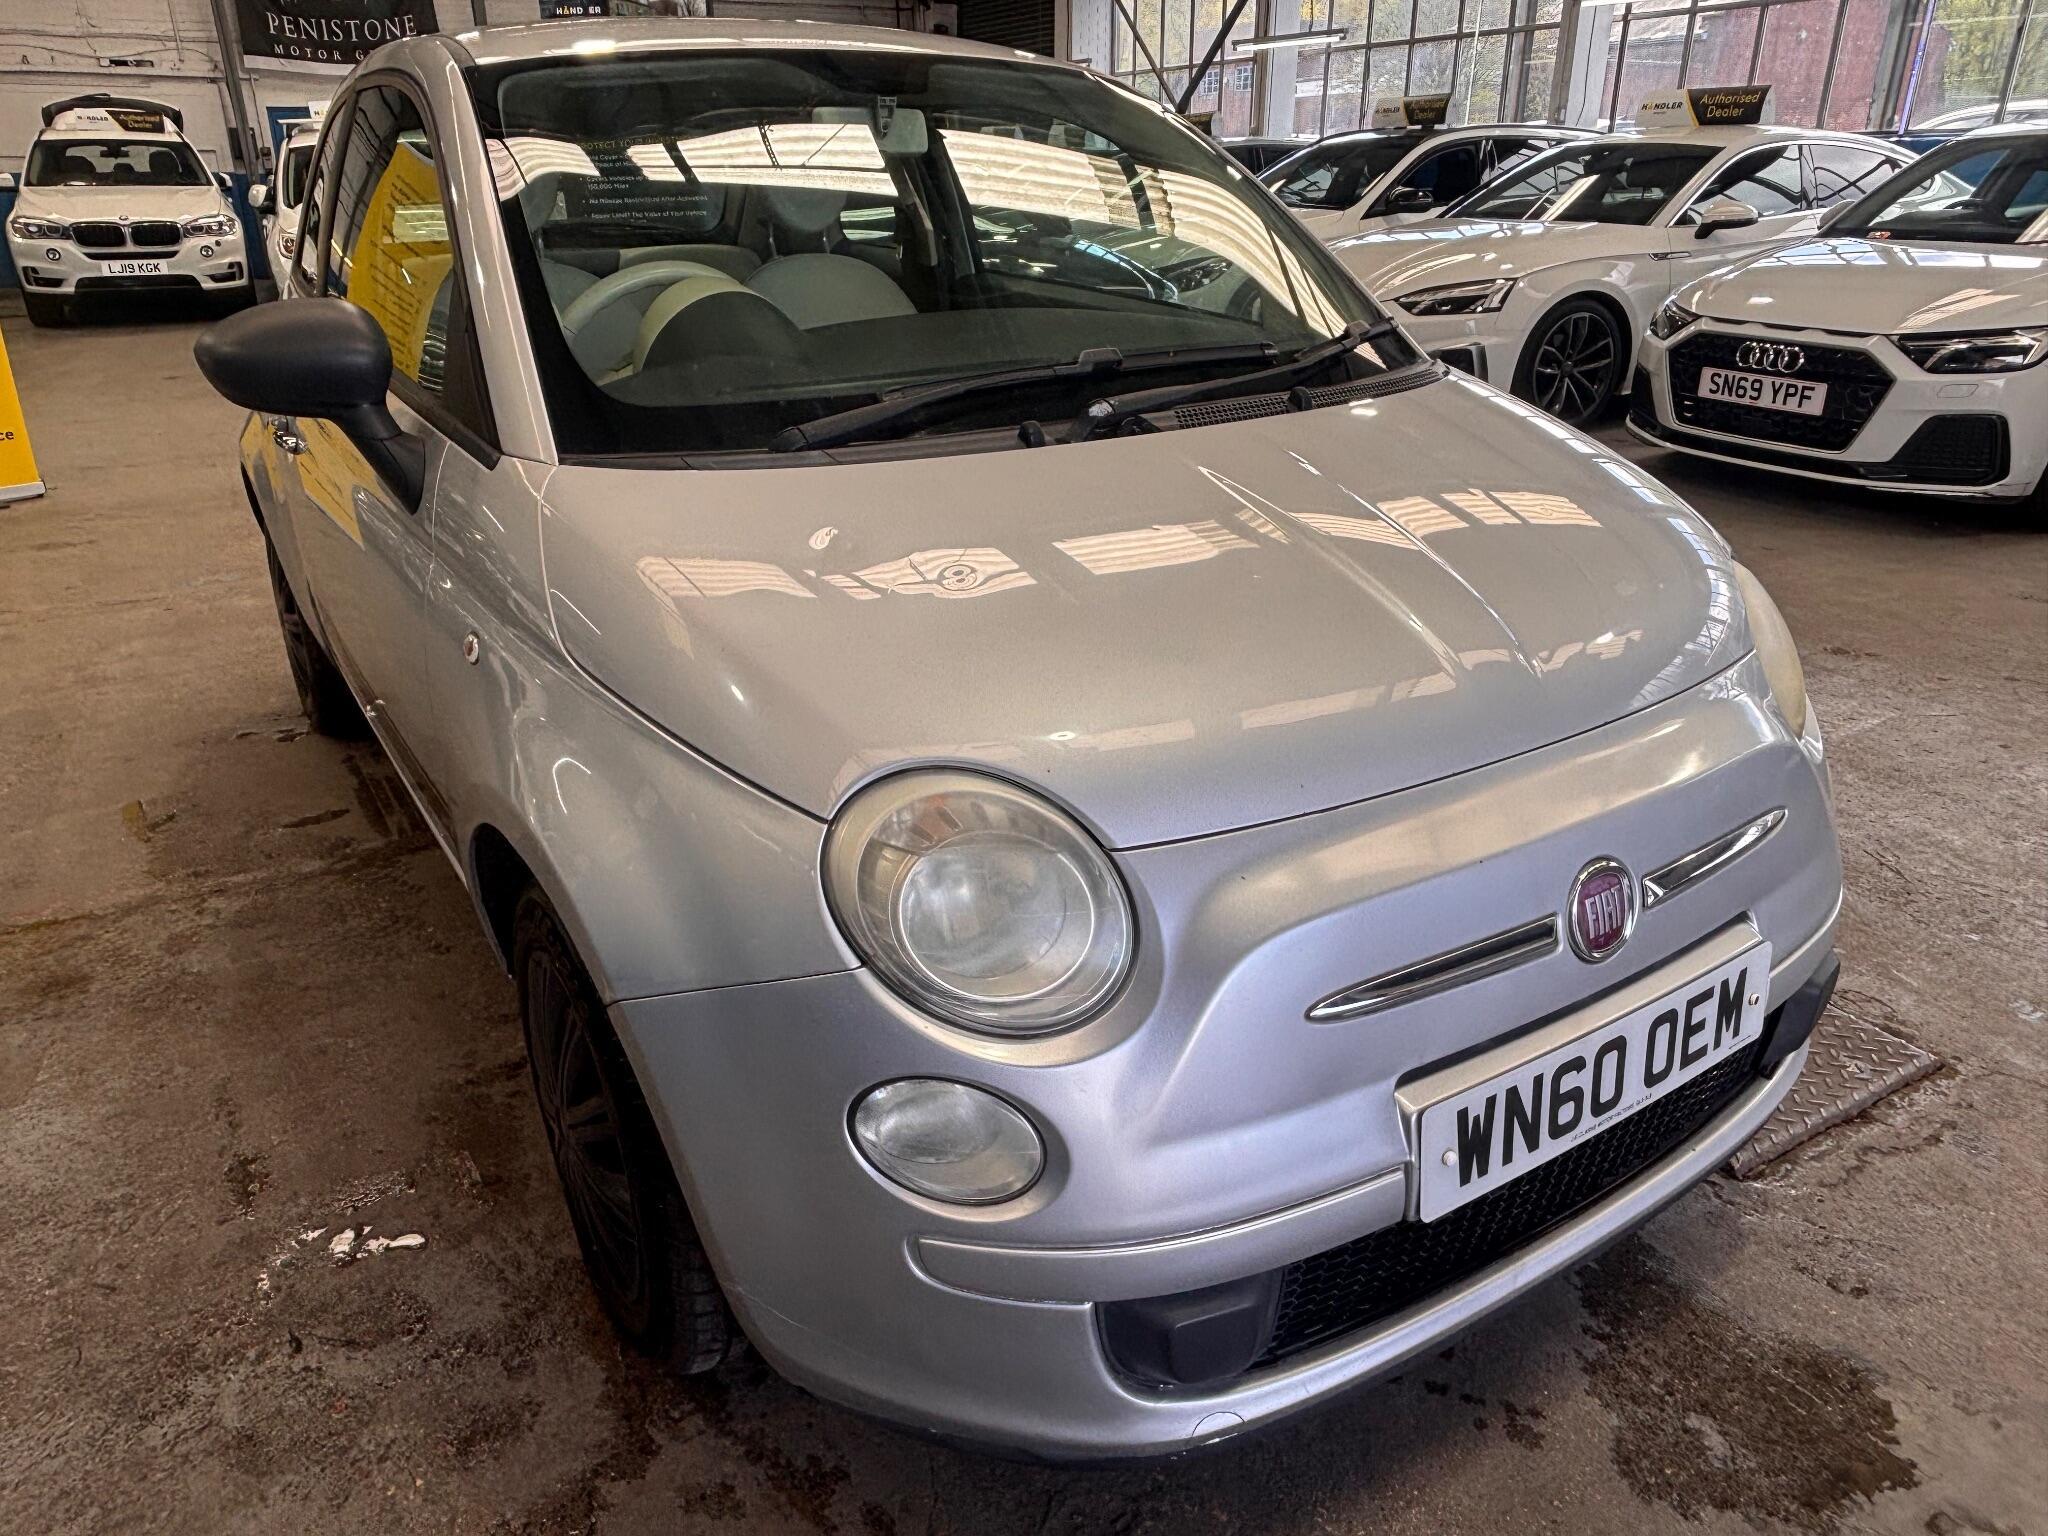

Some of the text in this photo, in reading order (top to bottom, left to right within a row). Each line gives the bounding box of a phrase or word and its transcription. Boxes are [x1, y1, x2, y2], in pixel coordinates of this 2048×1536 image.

[265, 12, 417, 42] PENISTONE
[274, 44, 342, 61] MOTOR
[1700, 91, 1761, 105] Authorised
[1706, 105, 1744, 117] Dealer
[107, 262, 161, 274] LJ19 KGK
[1708, 372, 1816, 409] SN69 YPF
[1584, 885, 1622, 940] FIAT
[1456, 966, 1748, 1188] WN60 OEM
